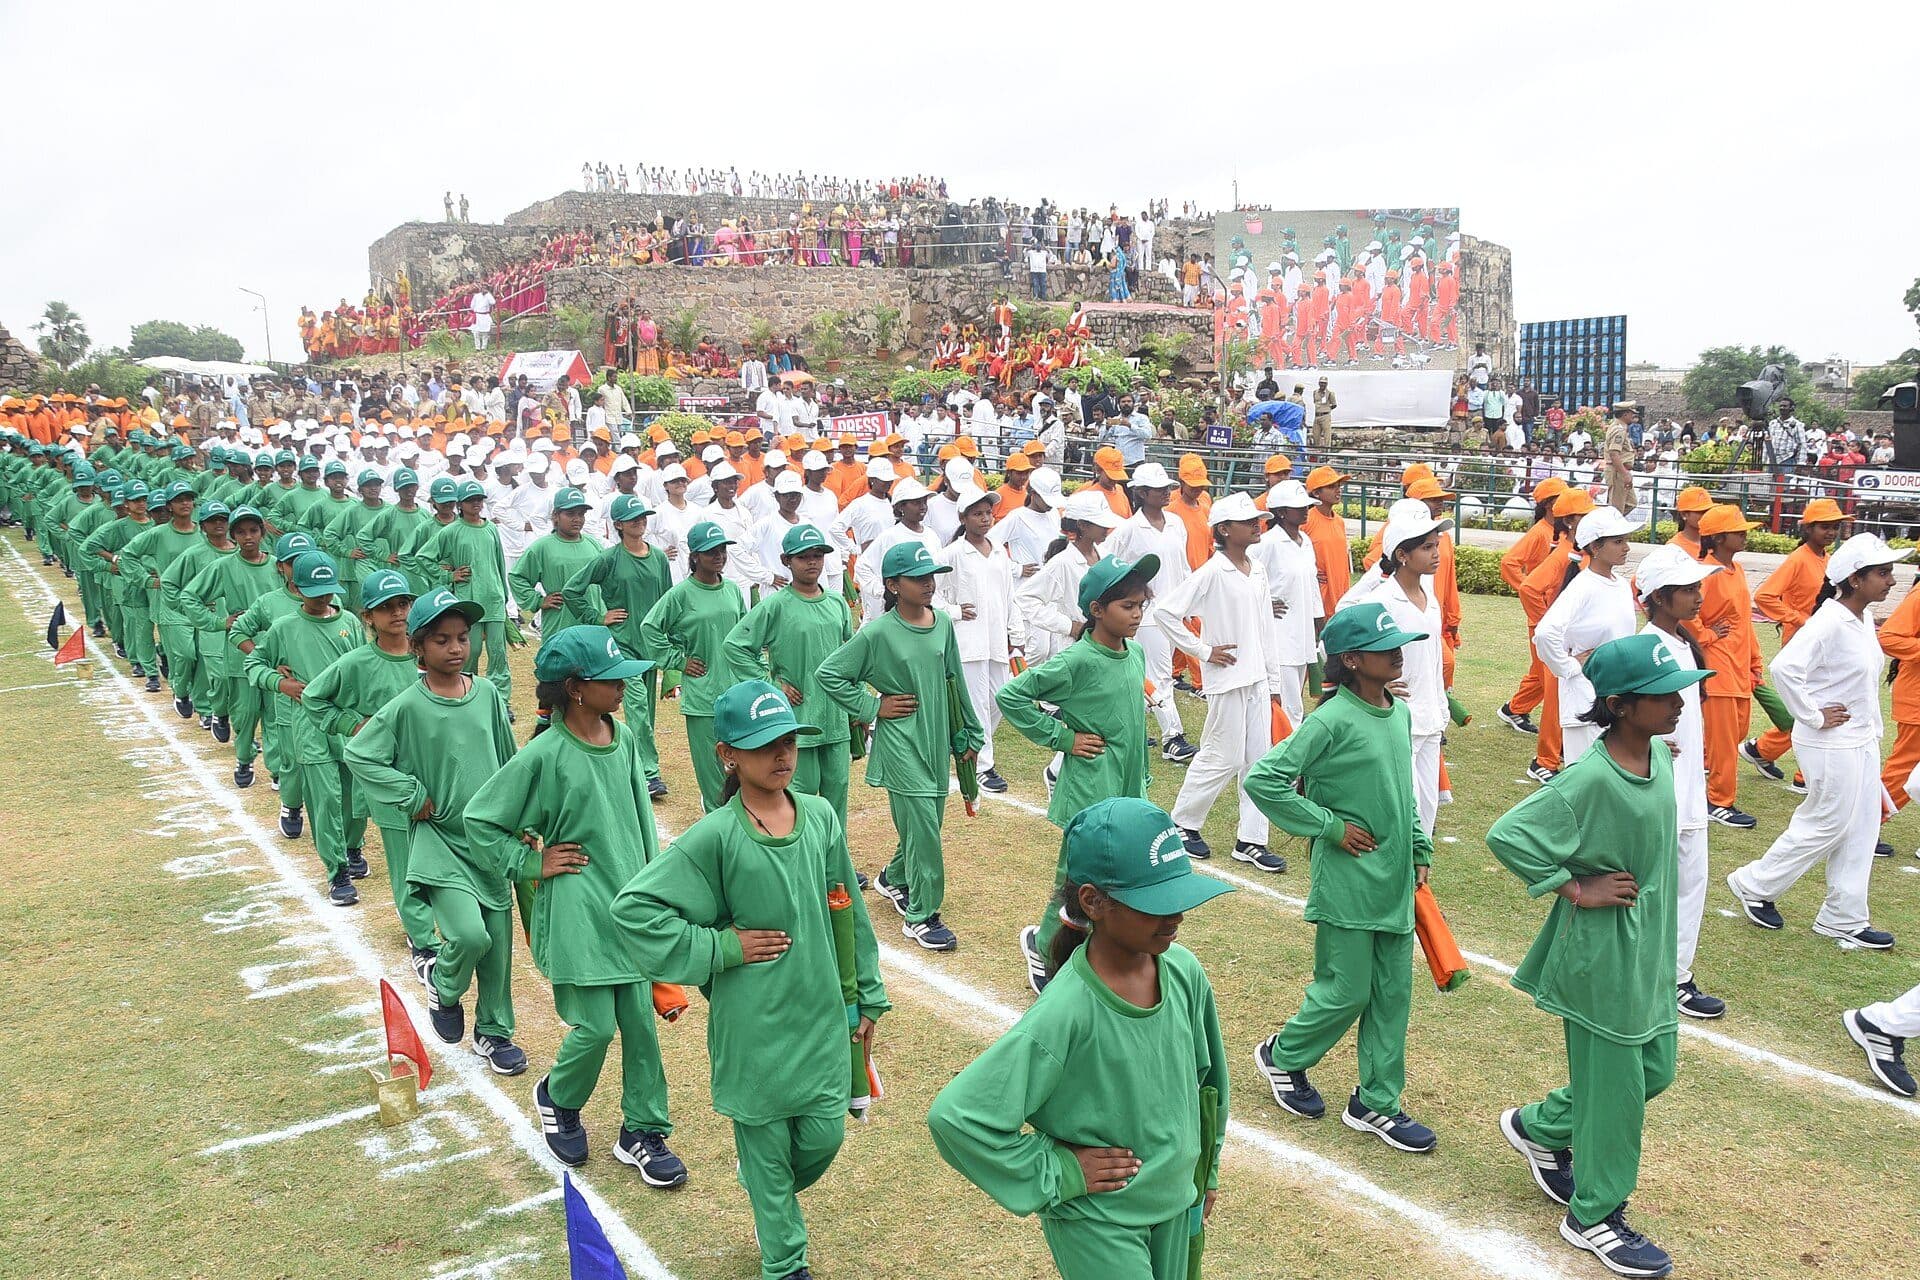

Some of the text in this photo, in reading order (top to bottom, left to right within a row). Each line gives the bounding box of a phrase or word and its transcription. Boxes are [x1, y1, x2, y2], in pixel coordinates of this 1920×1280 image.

[838, 416, 881, 438] PRESS
[1210, 436, 1228, 445] BLOCK
[1884, 474, 1920, 487] DOORD
